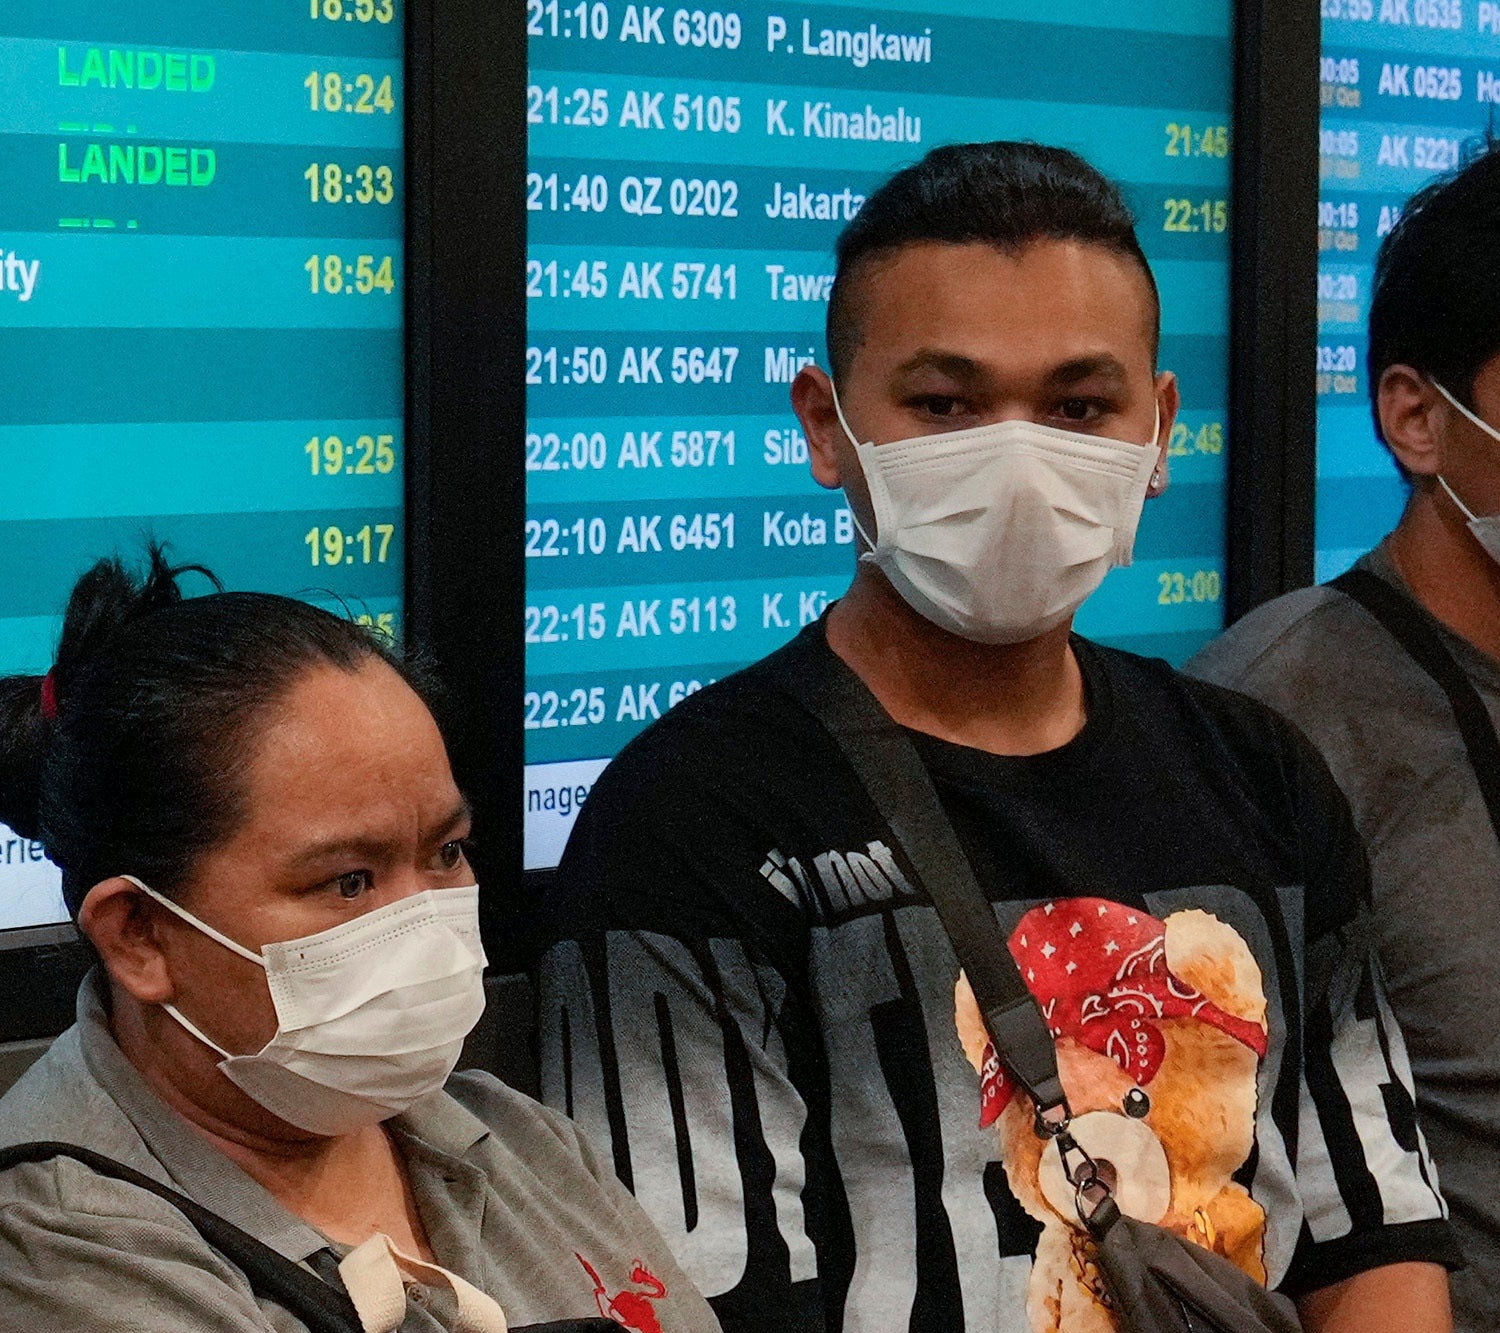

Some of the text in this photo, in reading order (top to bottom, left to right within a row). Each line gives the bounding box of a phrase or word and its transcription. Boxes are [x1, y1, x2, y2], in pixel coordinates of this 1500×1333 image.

[526, 0, 932, 68] 21:10 AK 6309 P. Langkawi
[58, 46, 216, 92] LANDED
[304, 70, 395, 115] 18:24
[1378, 63, 1411, 96] AK
[1413, 66, 1463, 100] 0525
[527, 85, 1229, 158] 21:25 AK 5105 K. Kinabalu 21:45
[58, 142, 217, 188] LANDED
[304, 162, 394, 205] 18:33
[1376, 135, 1408, 168] AK
[527, 172, 609, 213] 21:40
[619, 176, 663, 216] QZ
[670, 178, 738, 218] 0202
[1163, 198, 1227, 233] 22:15
[304, 254, 395, 295] 18:54
[527, 260, 835, 301] 21:45 AK 5741 Tawa
[525, 346, 607, 385] 21:50
[618, 346, 663, 384] AK
[671, 346, 739, 384] 5647
[304, 434, 395, 476] 19:25
[525, 422, 1223, 472] 22:00 AK 5871 Sib 2:45
[304, 524, 394, 567] 19:17
[524, 517, 607, 558] 22:10
[617, 515, 662, 553] AK
[669, 513, 735, 551] 6451
[762, 508, 829, 547] Kota
[524, 602, 606, 644] 22:15
[616, 599, 662, 638] AK
[669, 595, 737, 635] 5113
[762, 592, 791, 630] K.
[1157, 569, 1220, 605] 23:00
[523, 686, 606, 730] 22:25
[615, 682, 662, 722] AK
